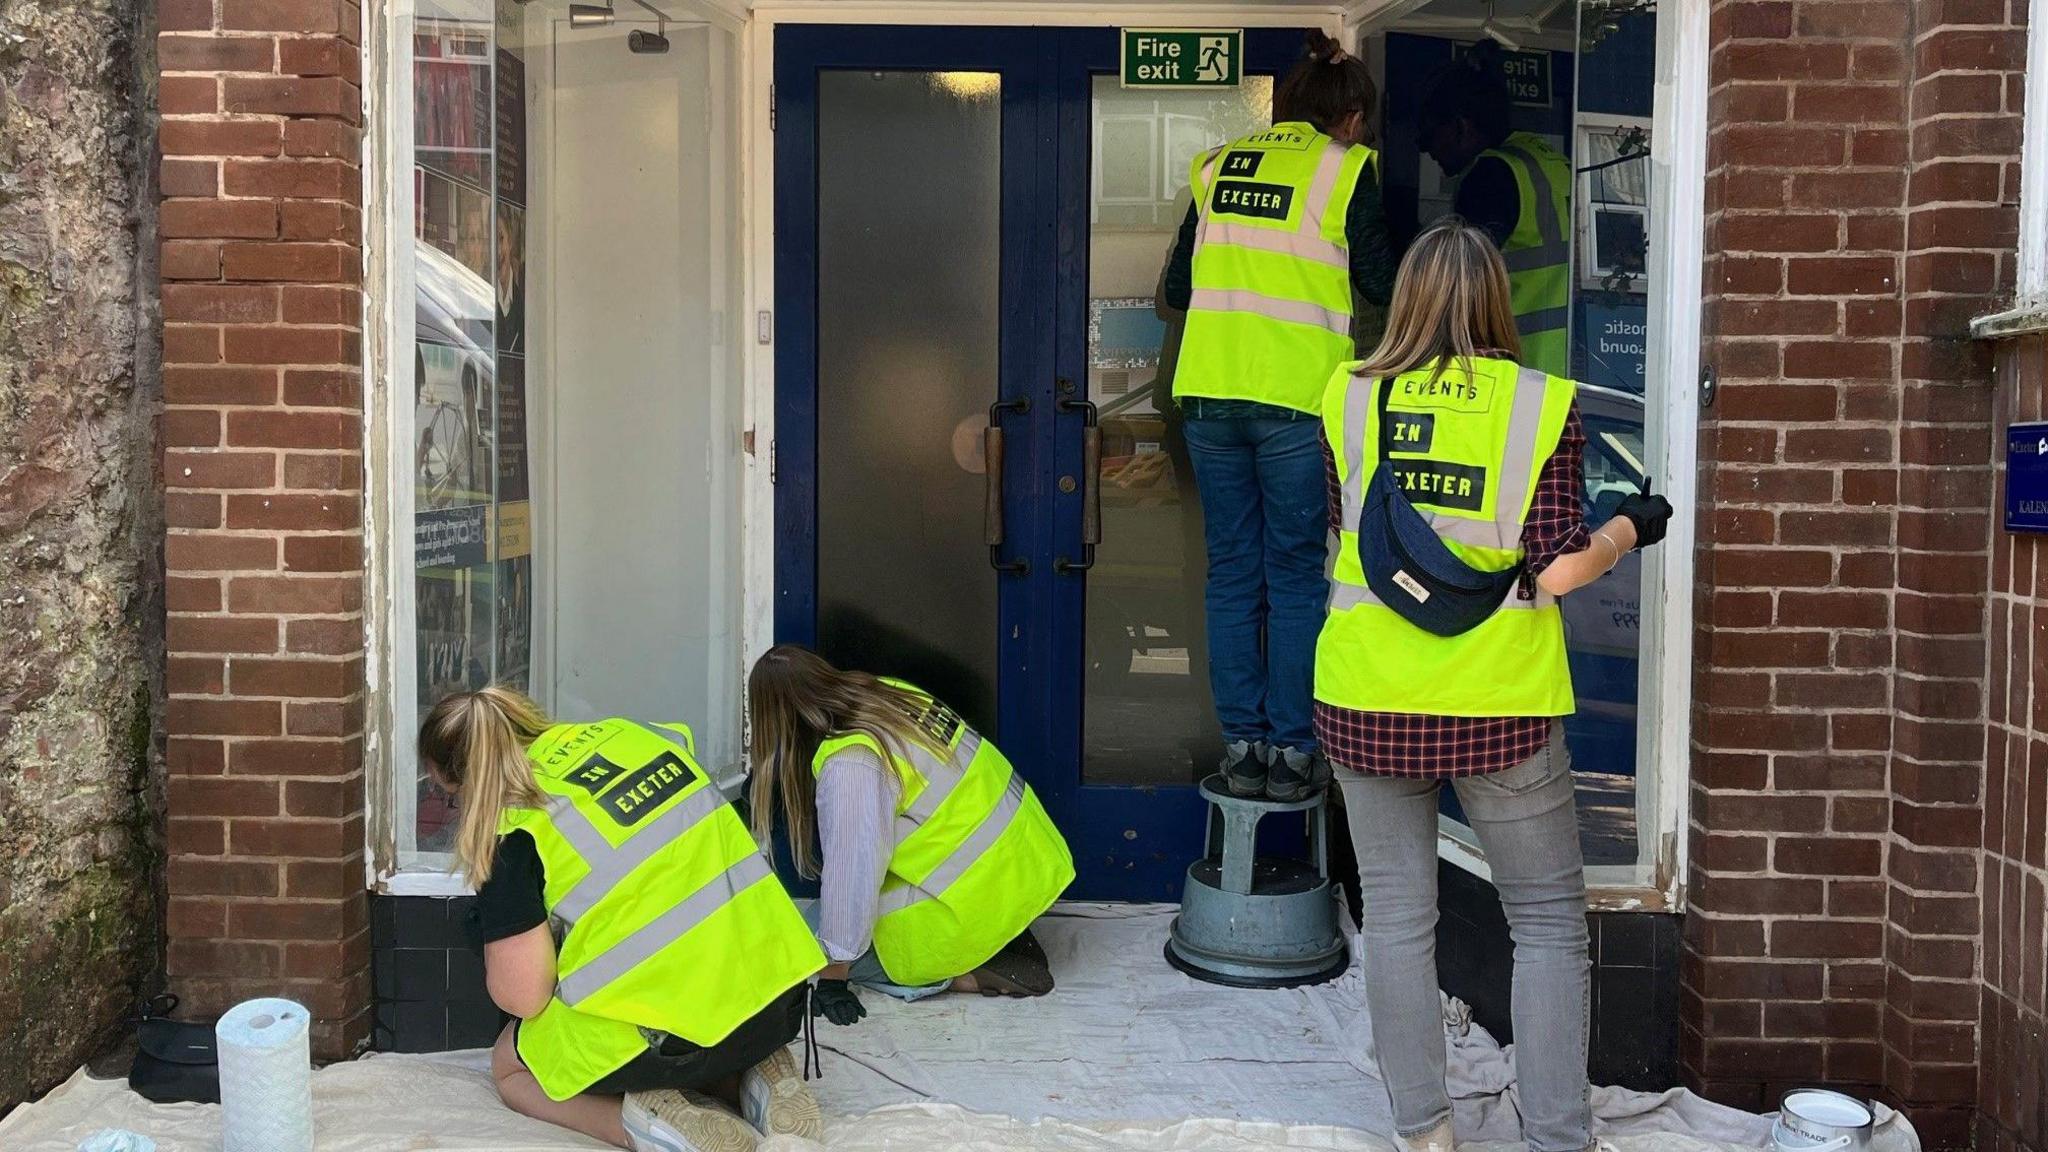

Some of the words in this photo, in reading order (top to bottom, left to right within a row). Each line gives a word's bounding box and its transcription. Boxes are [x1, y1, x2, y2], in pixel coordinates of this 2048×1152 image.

[1137, 38, 1181, 57] Fire
[1137, 61, 1180, 79] exit
[1230, 157, 1252, 169] IN
[1220, 190, 1281, 209] EXETER
[1404, 380, 1478, 400] EVENTS
[1393, 423, 1421, 442] IN
[2019, 500, 2048, 514] KALEN
[547, 724, 603, 765] EVENTS
[581, 765, 610, 782] IN
[615, 762, 683, 814] EXETER
[1800, 1130, 1827, 1143] TRADE
